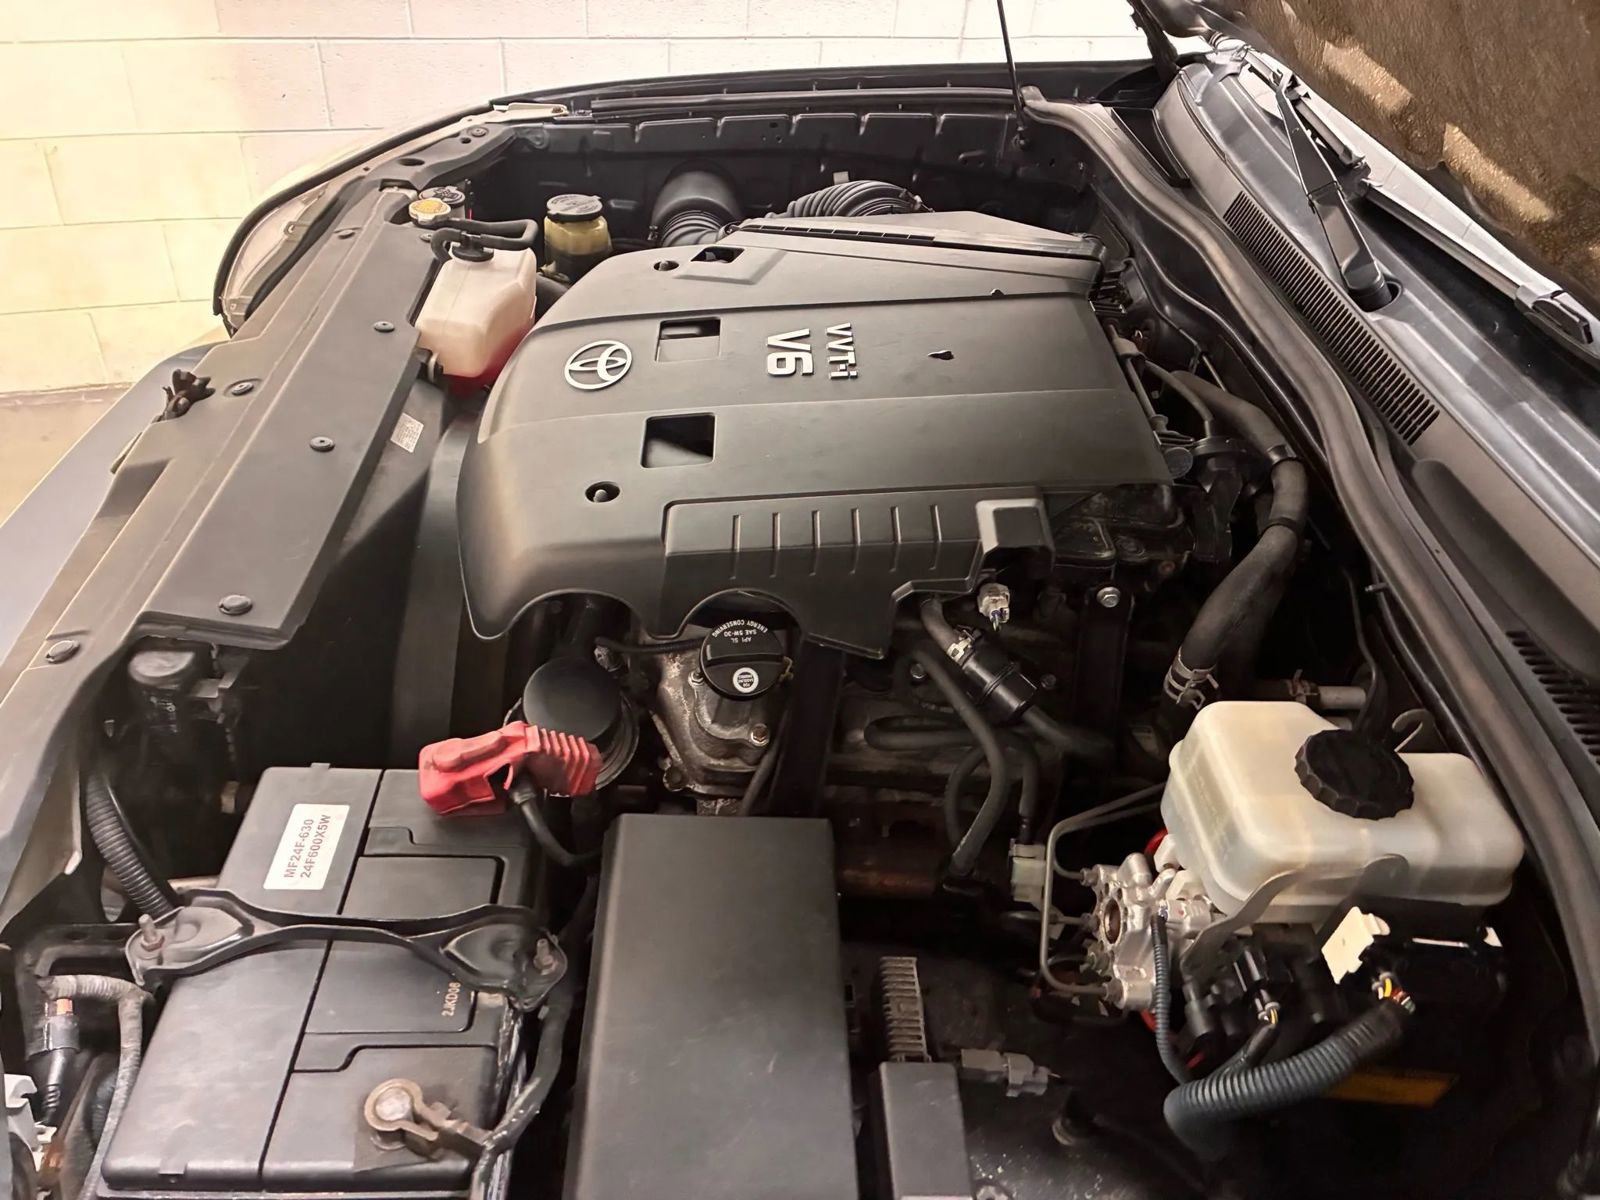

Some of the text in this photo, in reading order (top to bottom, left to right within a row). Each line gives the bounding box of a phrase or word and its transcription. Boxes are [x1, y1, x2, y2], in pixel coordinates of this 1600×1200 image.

[766, 328, 814, 376] V6
[826, 322, 858, 379] VVT-i
[712, 619, 768, 638] ENERGY CONSERVING
[284, 818, 315, 879] MF24F-630
[300, 814, 332, 879] 24F600X5W
